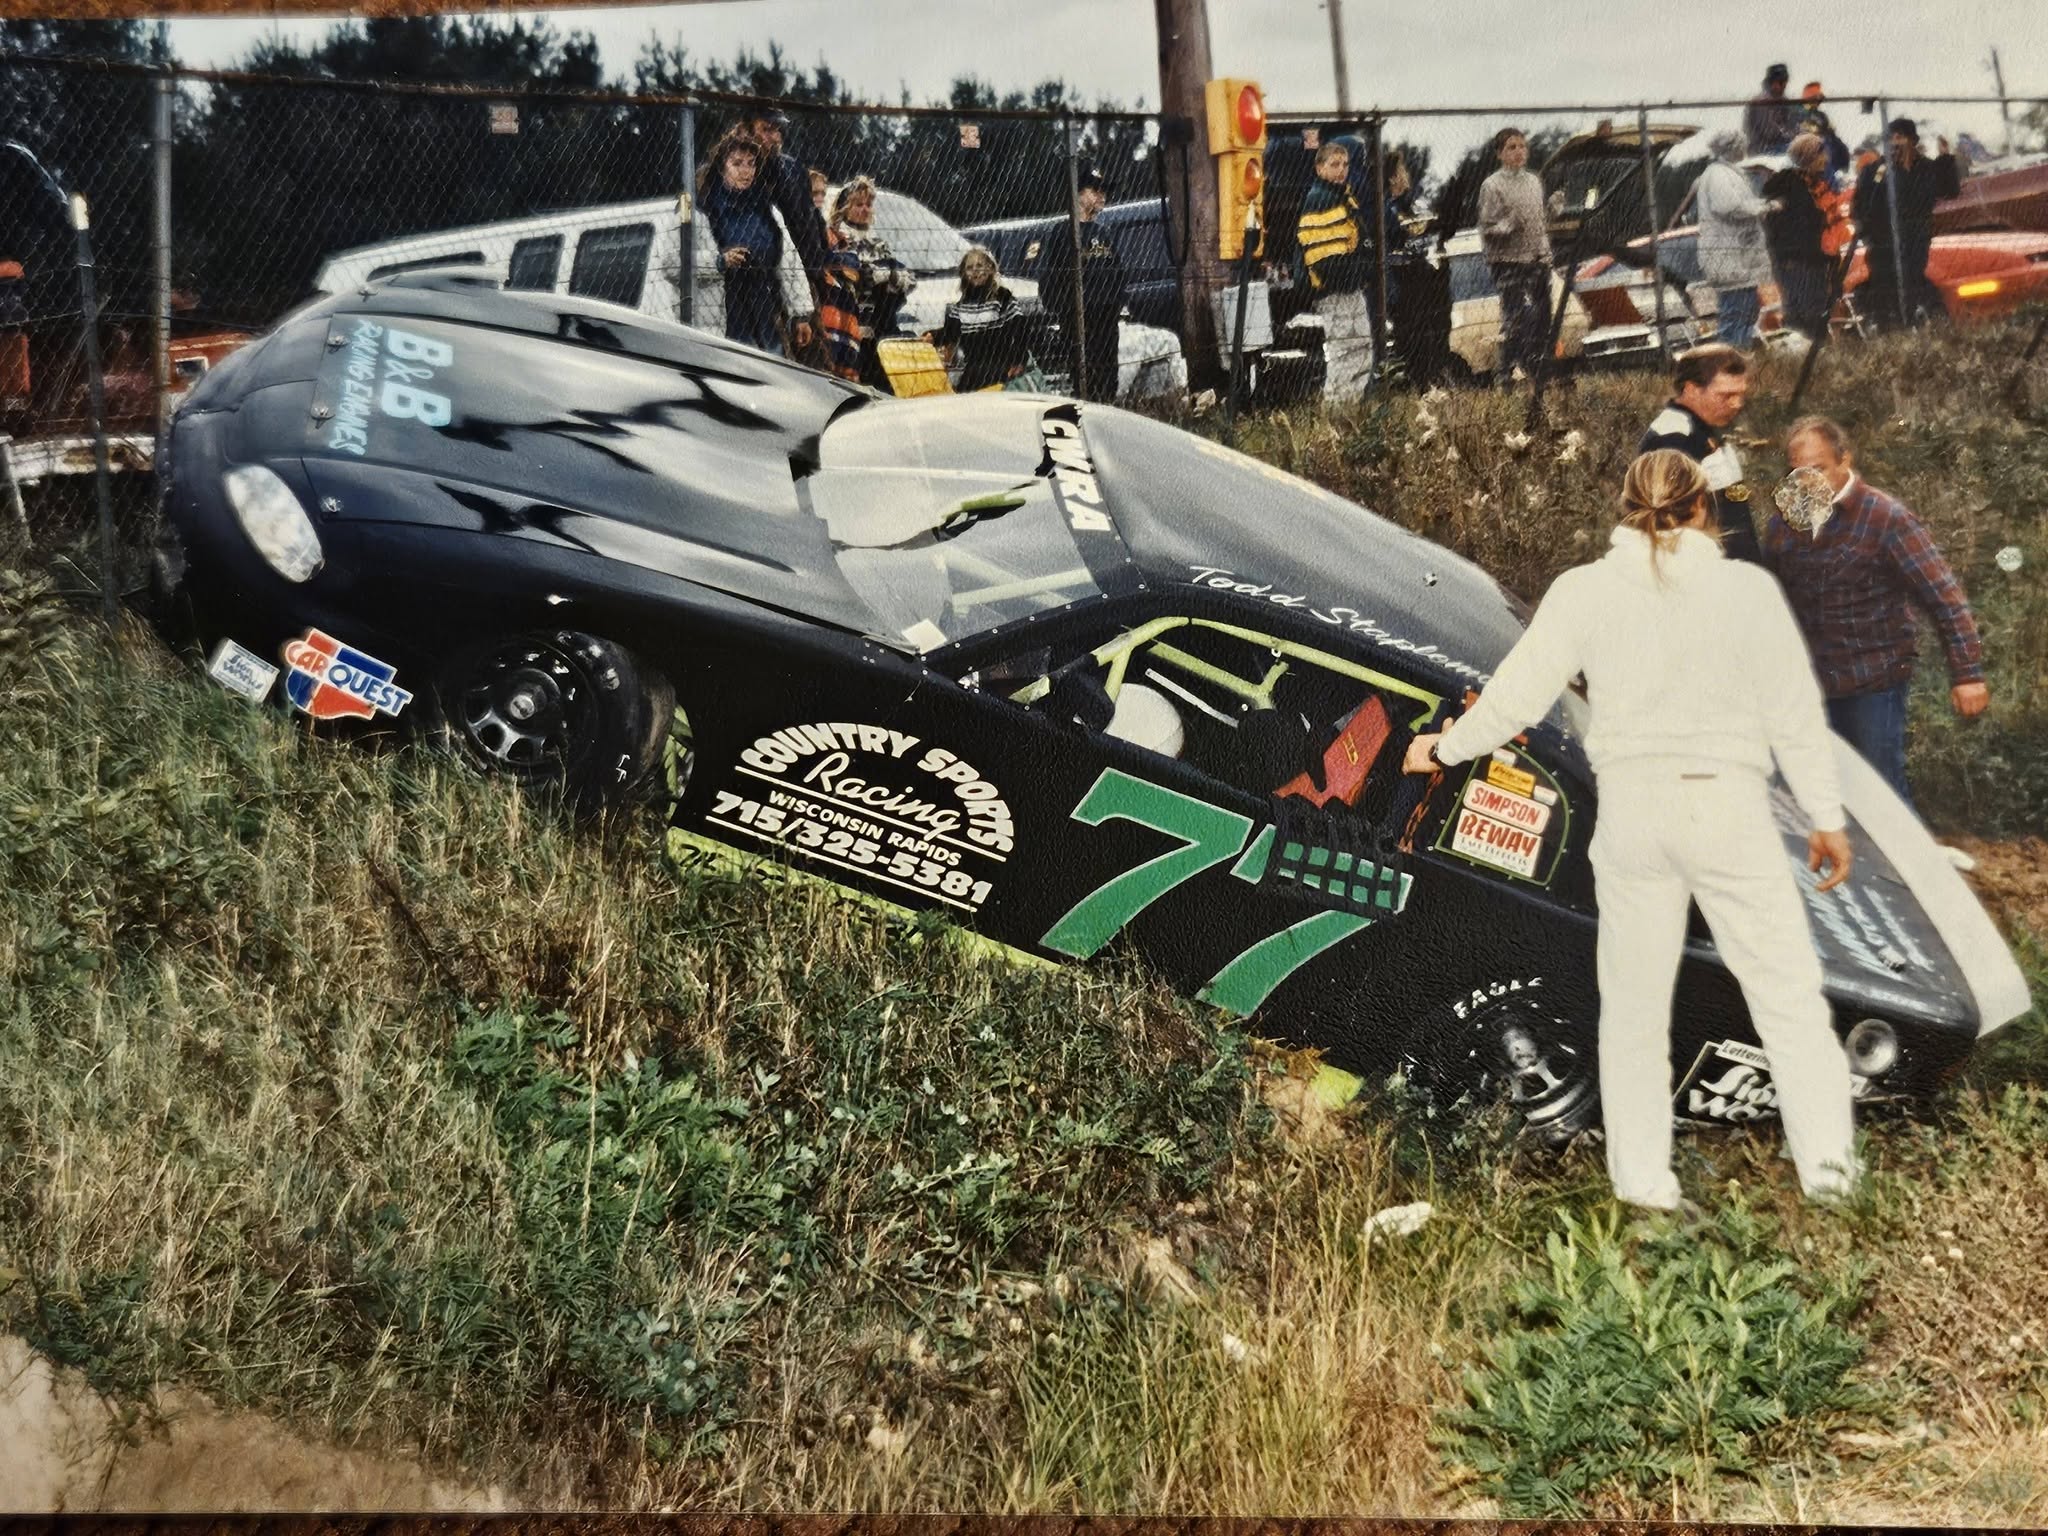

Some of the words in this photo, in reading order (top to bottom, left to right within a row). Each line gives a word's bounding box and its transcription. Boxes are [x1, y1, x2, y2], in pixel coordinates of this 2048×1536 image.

[328, 379, 373, 456] ENGINES
[380, 329, 454, 427] B&B
[1040, 418, 1111, 531] CWRA
[1190, 565, 1306, 608] Todd
[740, 722, 921, 774] COUNTRY
[917, 747, 1015, 853] SPORTS
[768, 790, 884, 841] WISCONSIN
[886, 831, 963, 867] RAPIDS
[803, 751, 962, 842] Racing
[1471, 787, 1542, 826] SIMPSON
[711, 790, 994, 905] 715/325-5381
[1038, 766, 1415, 1018] 77
[1699, 1064, 1779, 1109] Sig
